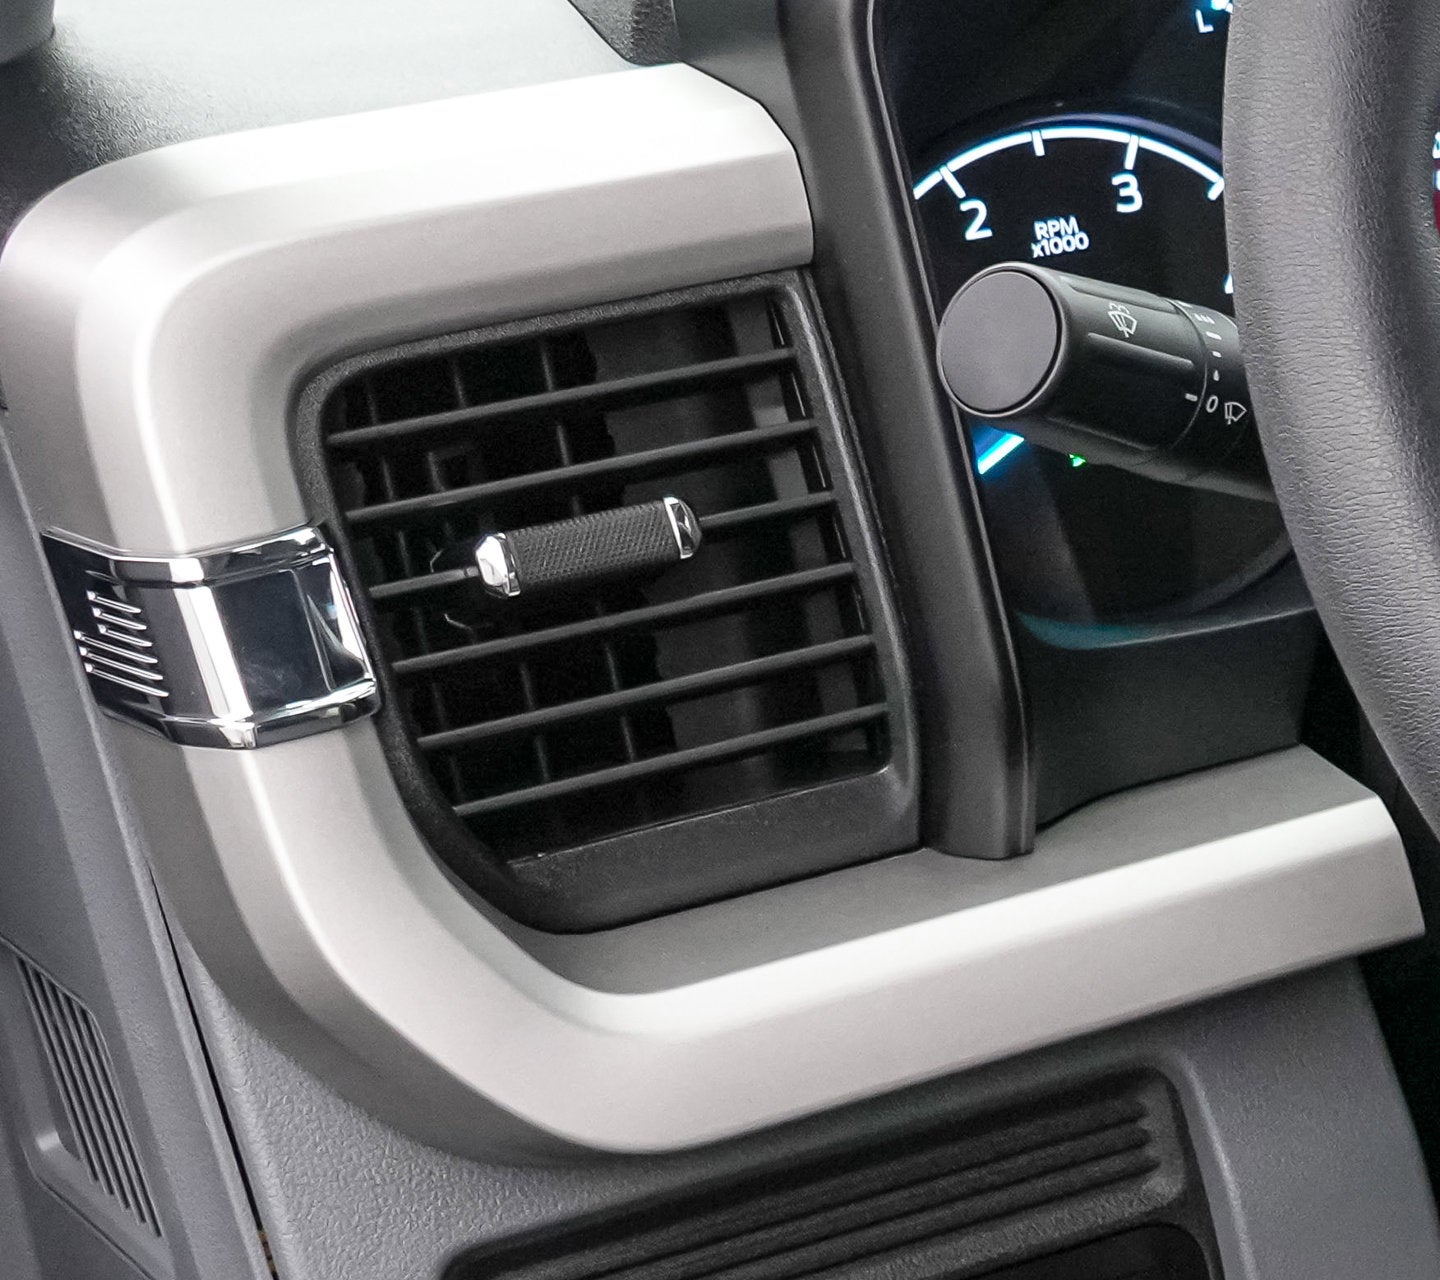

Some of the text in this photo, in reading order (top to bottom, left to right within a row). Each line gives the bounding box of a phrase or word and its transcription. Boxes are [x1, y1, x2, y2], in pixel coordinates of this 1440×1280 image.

[1195, 8, 1214, 33] L
[1112, 173, 1143, 212] 3
[959, 198, 993, 241] 2
[1034, 216, 1080, 241] RPM
[1031, 233, 1090, 258] x1000
